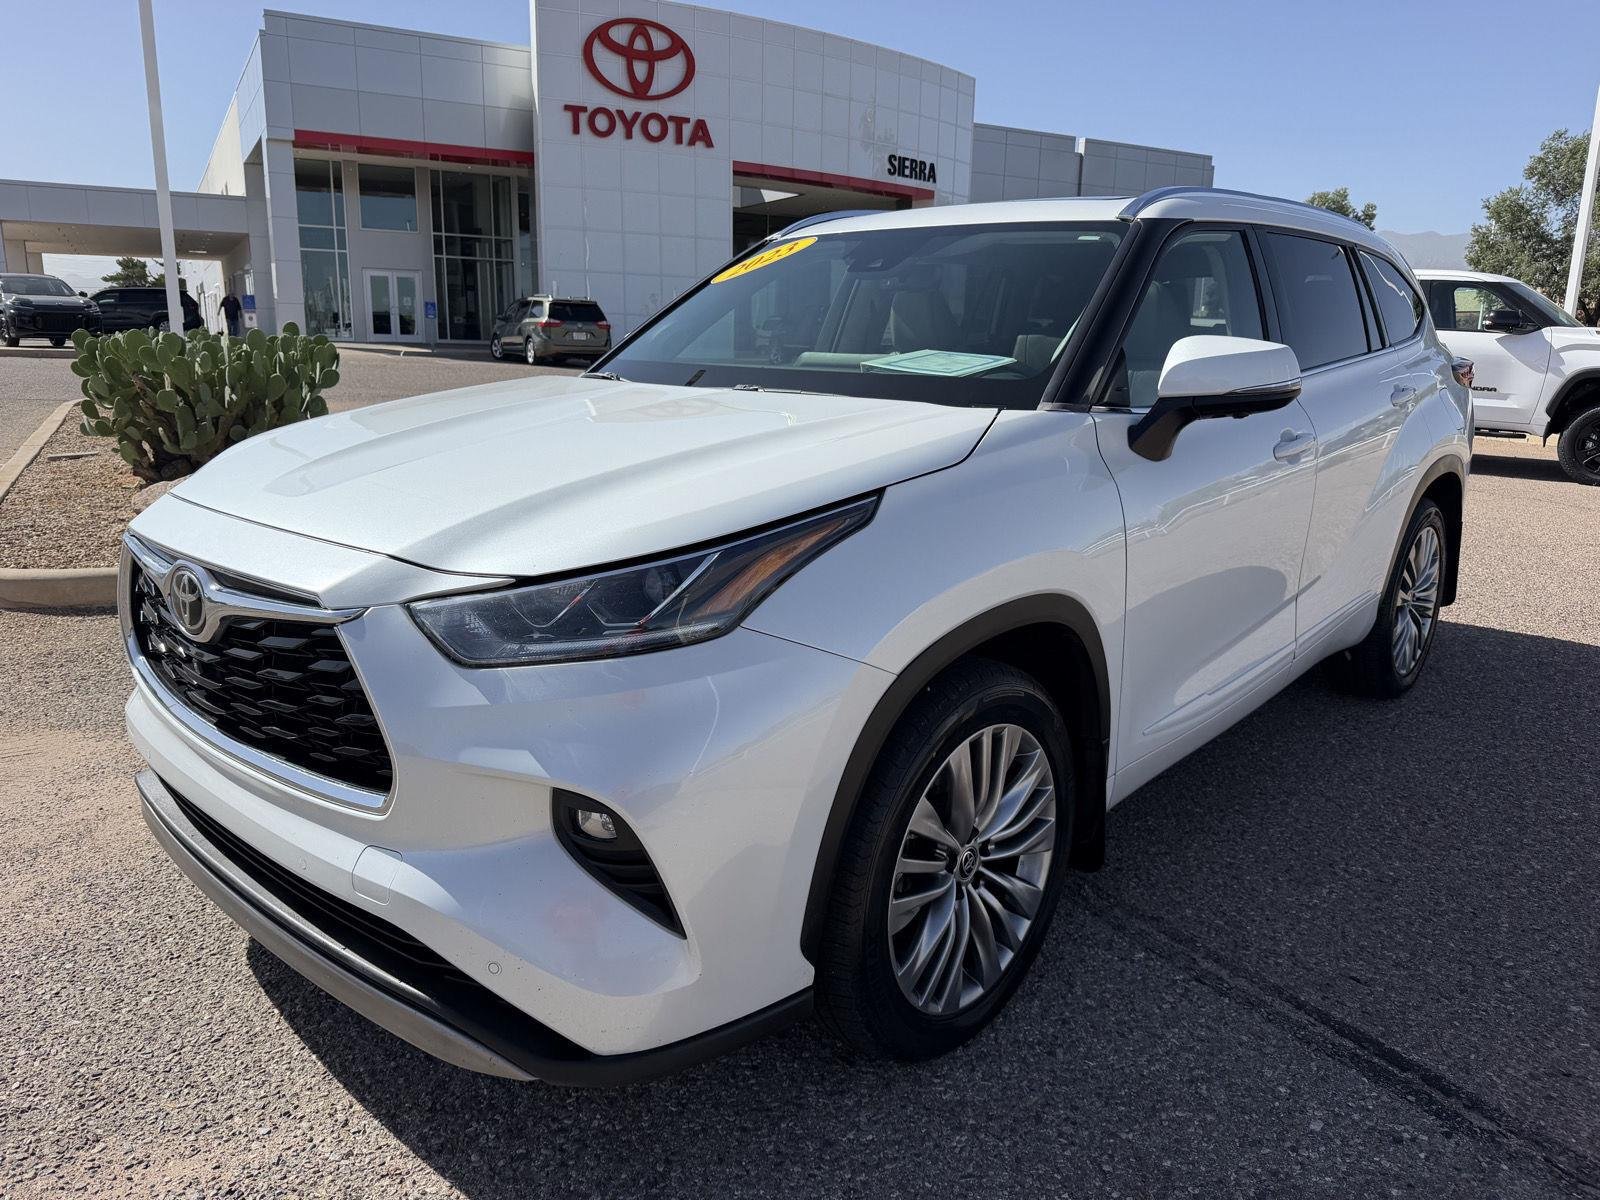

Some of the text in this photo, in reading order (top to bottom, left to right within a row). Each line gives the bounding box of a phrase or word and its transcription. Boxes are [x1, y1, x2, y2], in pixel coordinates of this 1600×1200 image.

[564, 104, 714, 148] TOYOTA
[887, 154, 937, 184] SIERRA
[729, 241, 799, 276] 2023
